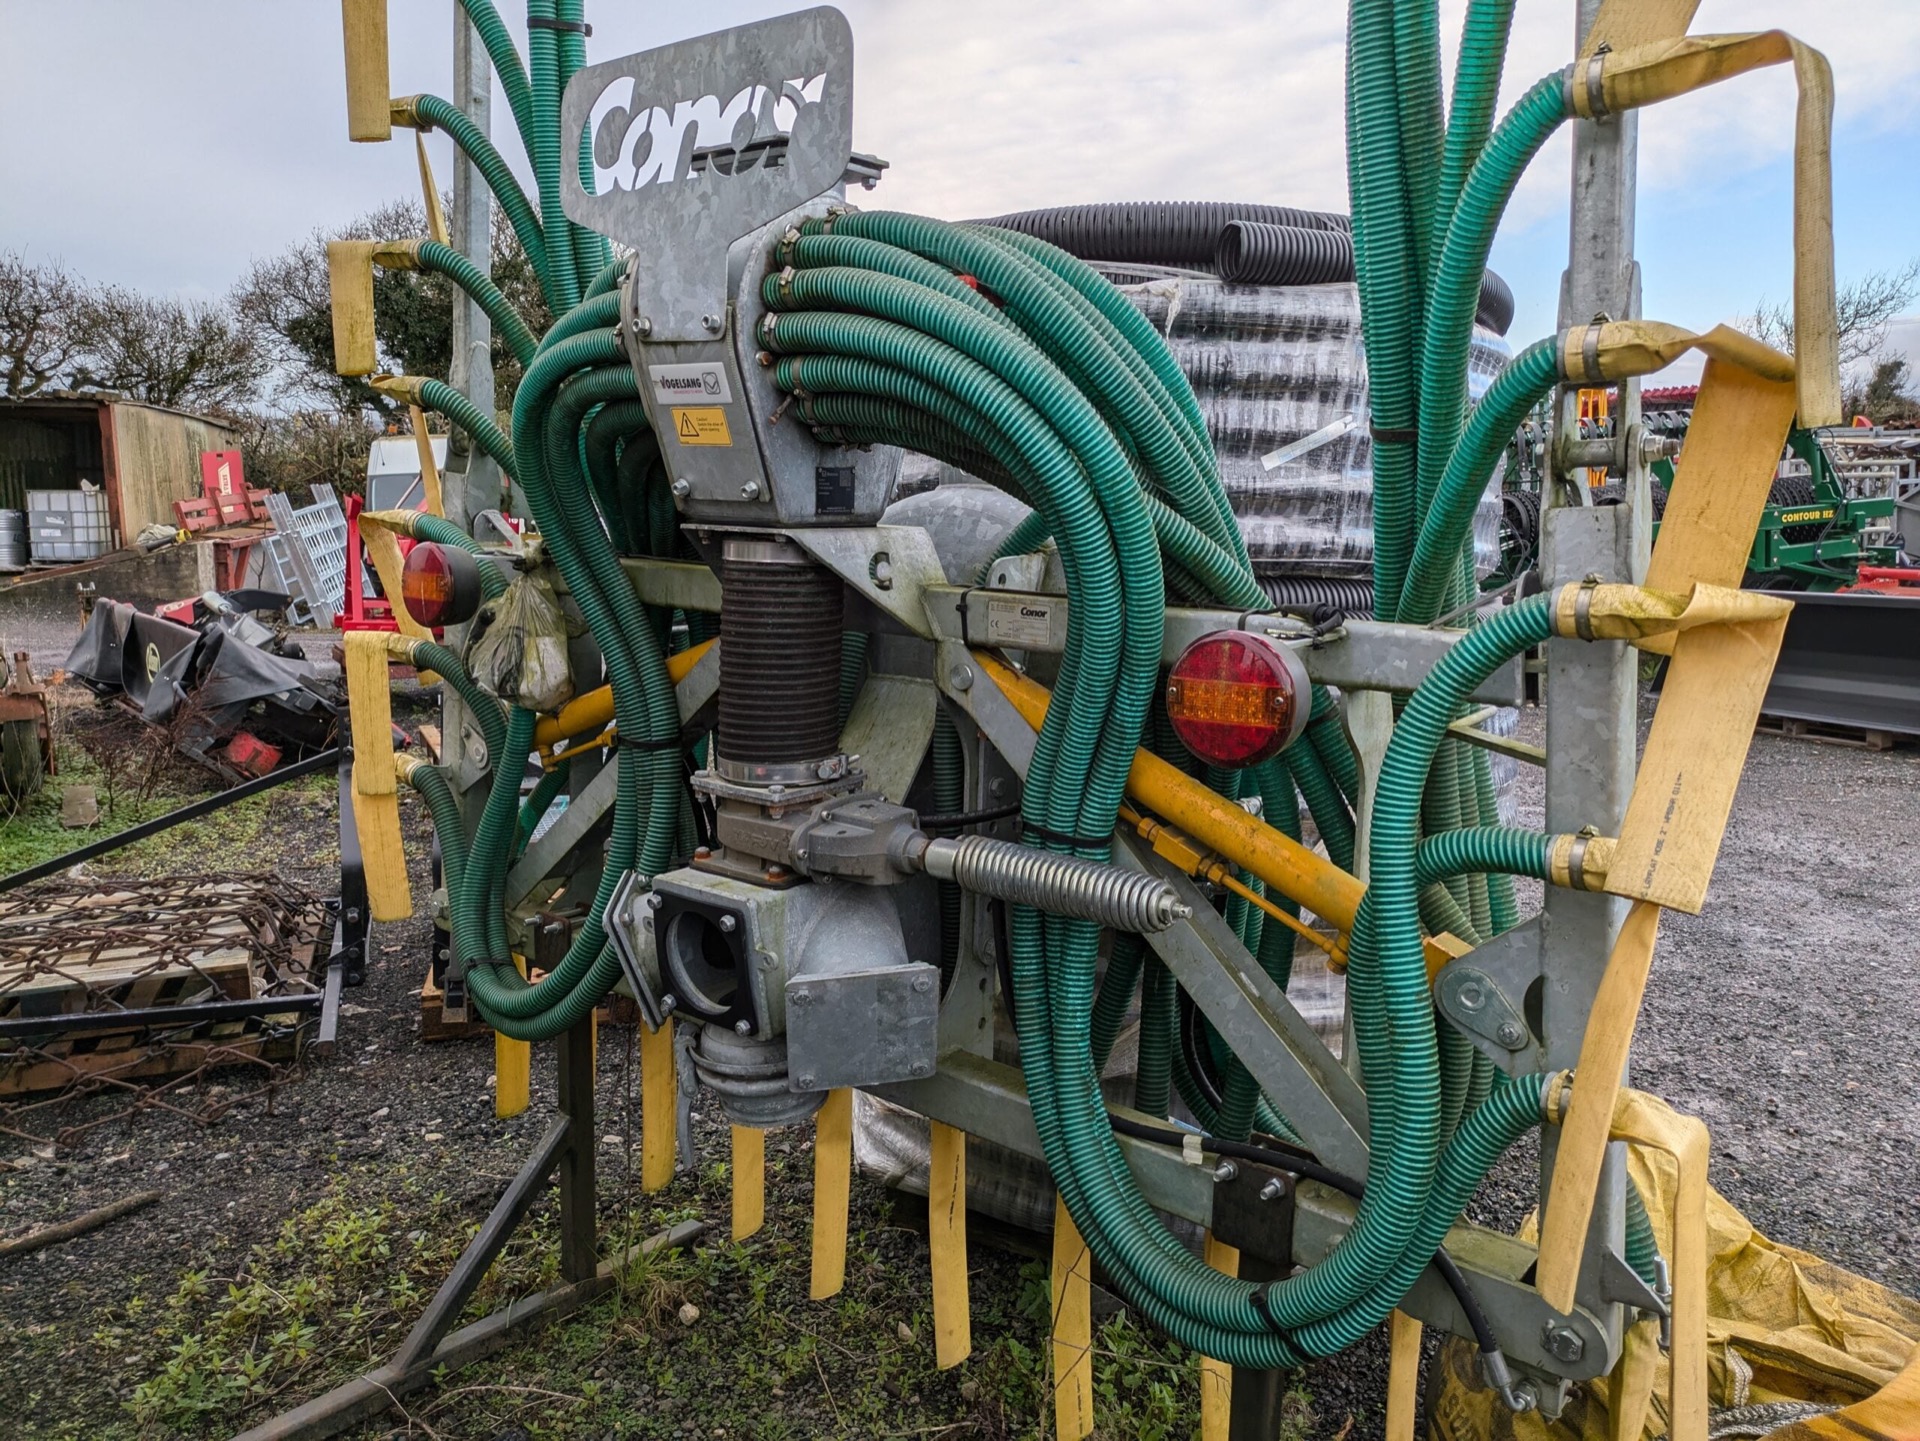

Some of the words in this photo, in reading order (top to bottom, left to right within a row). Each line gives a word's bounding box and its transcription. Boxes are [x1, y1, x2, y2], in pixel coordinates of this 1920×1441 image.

[578, 73, 827, 197] Conor
[660, 375, 702, 390] VOGELSANG
[1781, 511, 1820, 522] CONTOUR
[1020, 606, 1048, 618] Conor
